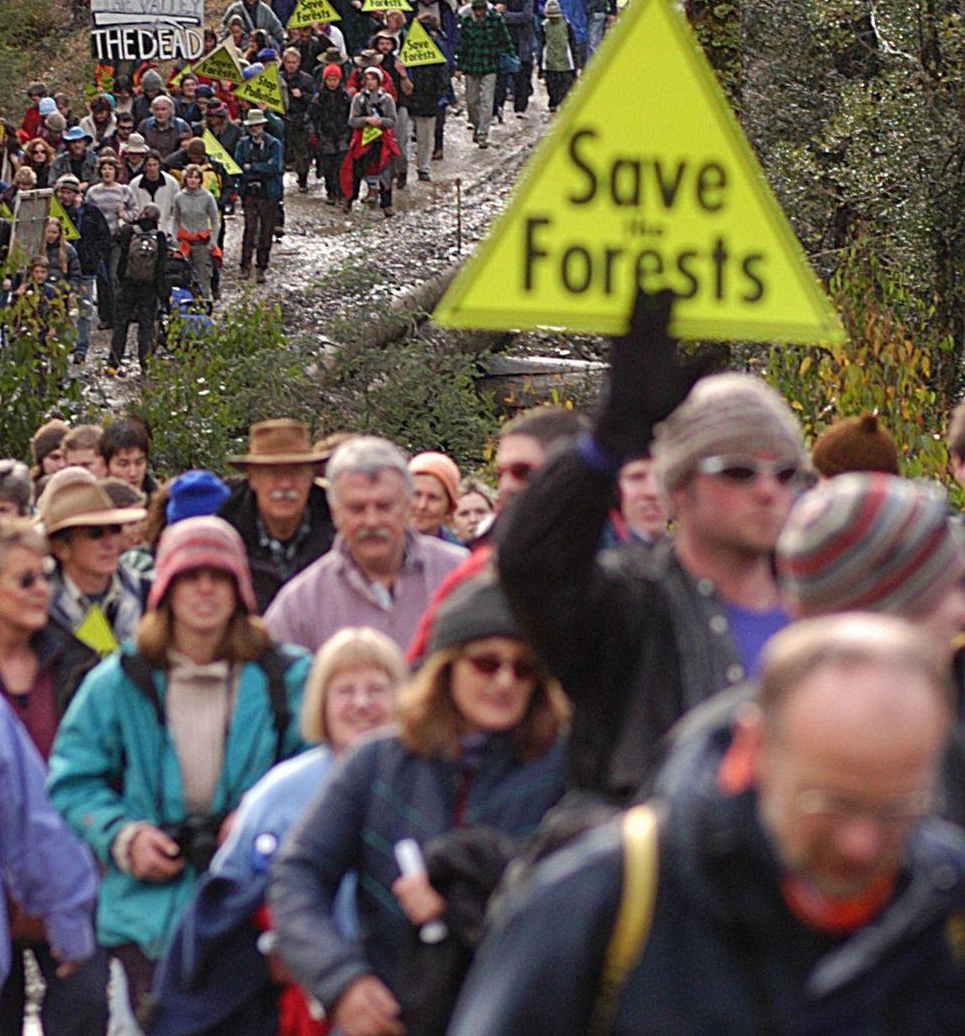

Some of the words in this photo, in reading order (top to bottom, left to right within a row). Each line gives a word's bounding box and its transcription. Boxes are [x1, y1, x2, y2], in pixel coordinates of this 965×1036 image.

[300, 0, 323, 11] Save
[296, 9, 331, 22] Forests
[91, 29, 136, 60] THE
[137, 28, 203, 60] DEAD
[406, 39, 430, 50] Save
[403, 49, 436, 62] Forests
[258, 75, 277, 92] Stop
[243, 84, 281, 106] Pollution
[567, 129, 730, 214] Save
[521, 218, 766, 305] Forests
